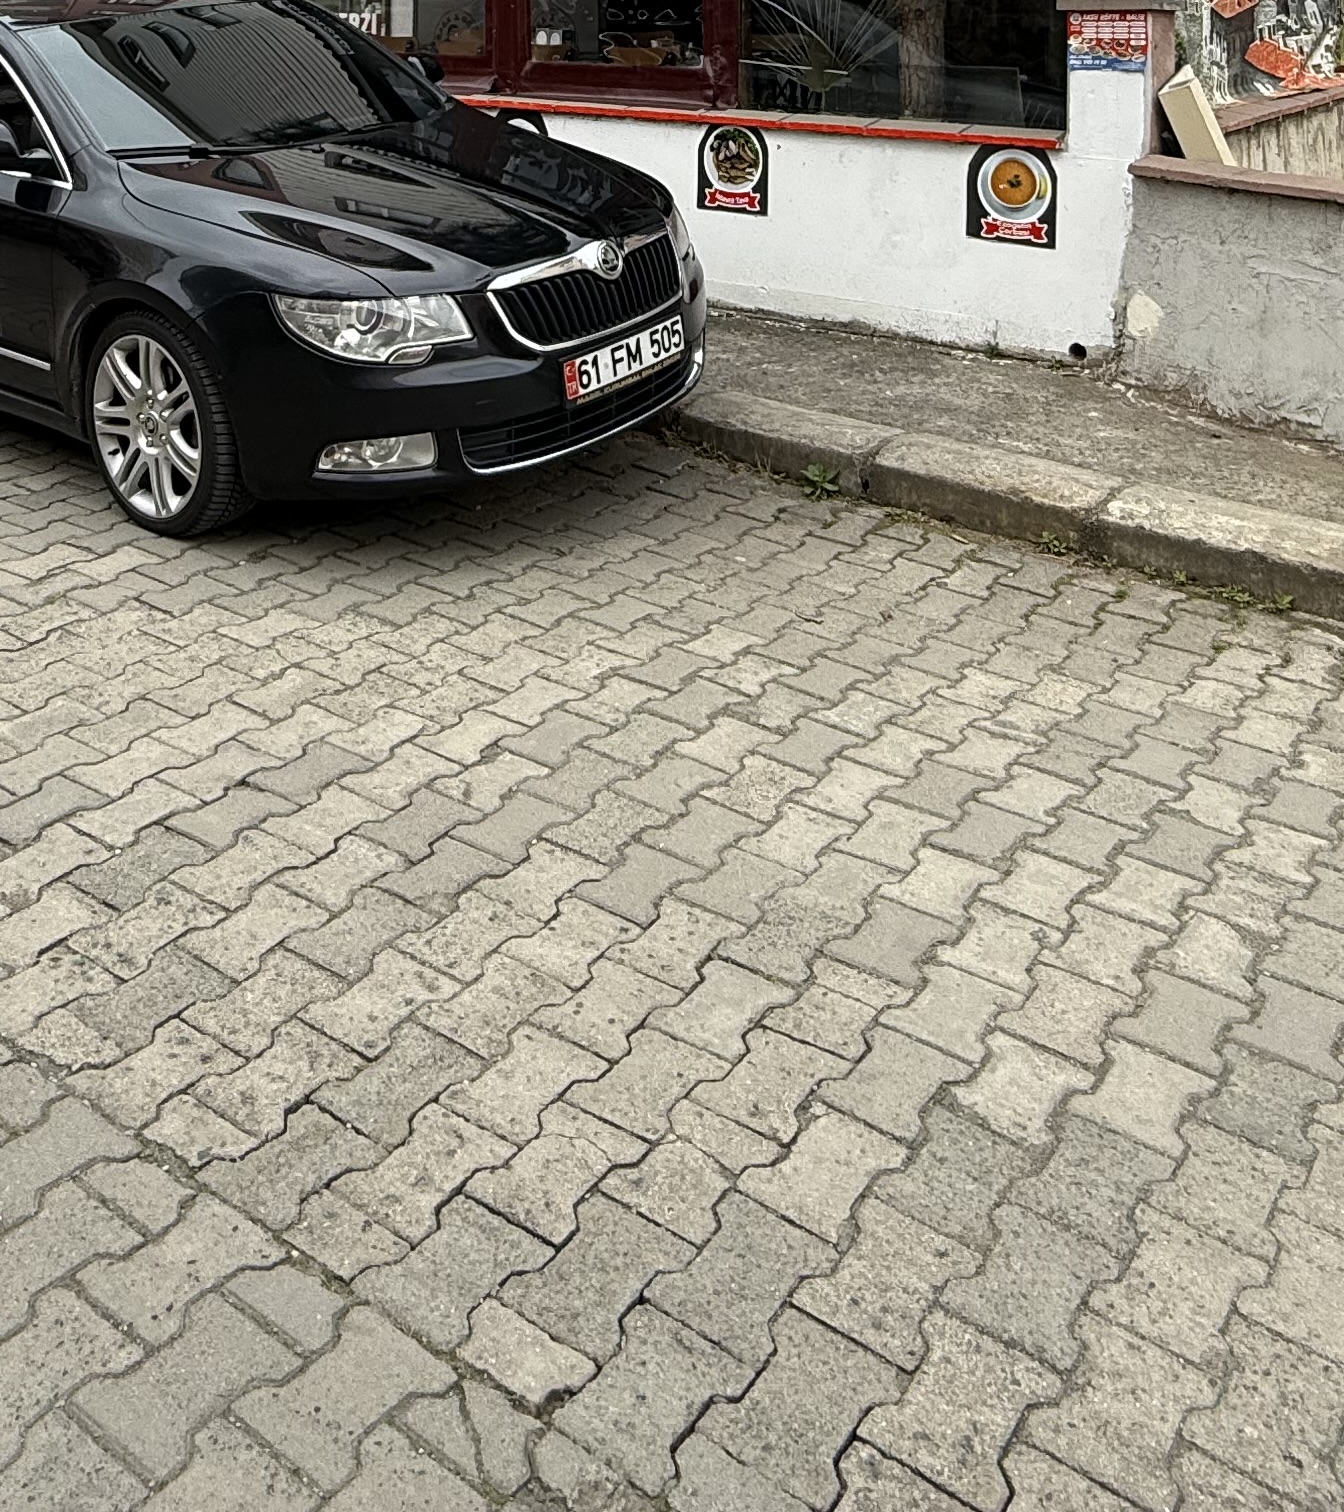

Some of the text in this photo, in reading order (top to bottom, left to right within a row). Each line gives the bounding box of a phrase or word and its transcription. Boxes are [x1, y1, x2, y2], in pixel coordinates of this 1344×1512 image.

[577, 354, 601, 390] 61
[610, 337, 643, 377] FM
[649, 319, 682, 358] 505
